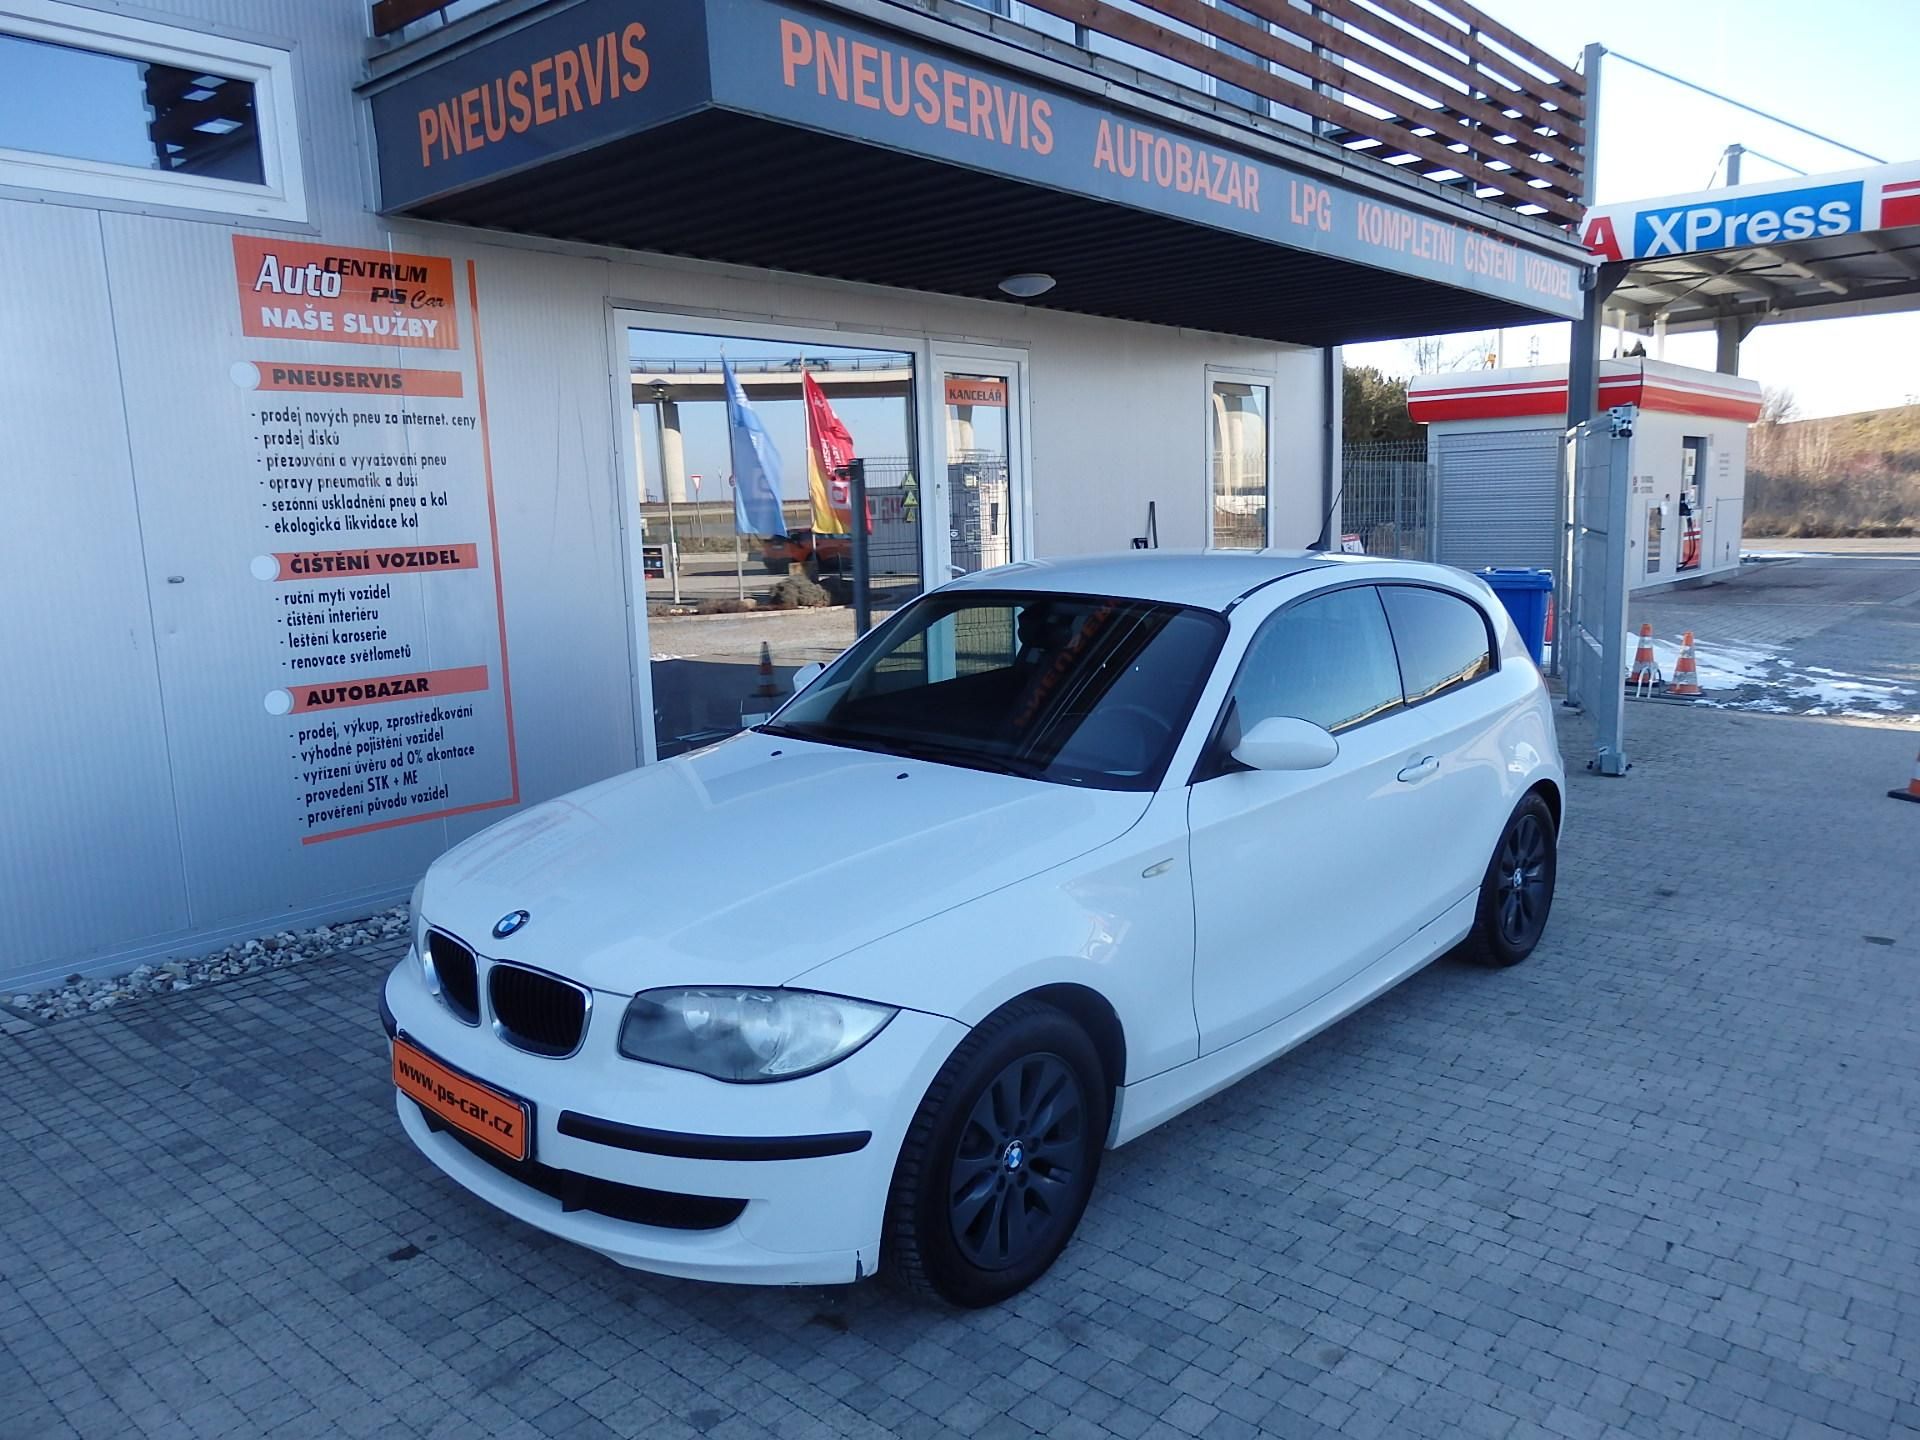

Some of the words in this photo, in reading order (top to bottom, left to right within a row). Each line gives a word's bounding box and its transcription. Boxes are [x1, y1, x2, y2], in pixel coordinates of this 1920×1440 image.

[418, 22, 650, 168] PNEUSERVIS
[780, 18, 1054, 155] PNEUSERVIS
[1093, 118, 1260, 213] AUTOBAZAR
[1291, 180, 1331, 233] LPG
[1358, 201, 1457, 265] KOMPLETNÍ
[1464, 225, 1520, 283] ČIŠTĚNÍ
[1523, 255, 1572, 300] VOZIDEL
[1642, 201, 1851, 258] XPress
[254, 253, 342, 299] Auto
[324, 257, 428, 284] CENTRUM
[370, 286, 408, 305] PS
[411, 290, 446, 309] Car
[261, 303, 335, 332] NAŠE
[343, 310, 438, 339] SLUŽBY
[272, 368, 403, 389] PNEUSERVIS
[949, 387, 1002, 402] KANCELÁŘ
[261, 406, 302, 426] prodej
[306, 408, 348, 427] nových
[353, 413, 380, 428] pneu
[385, 414, 398, 424] za
[402, 409, 448, 425] internet.
[452, 416, 476, 430] ceny
[264, 428, 304, 449] prodej
[308, 429, 340, 445] disků
[267, 452, 335, 471] přezouvání
[340, 456, 346, 466] a
[351, 453, 417, 470] vyvažování
[421, 455, 447, 469] pneu
[269, 478, 313, 493] opravy
[318, 472, 381, 493] pneumatik
[385, 477, 392, 487] a
[397, 471, 418, 487] duší
[272, 496, 318, 511] sezónní
[322, 493, 385, 509] uskladnění
[390, 497, 416, 511] pneu
[420, 497, 427, 506] a
[431, 491, 448, 506] kol
[274, 516, 341, 536] ekologická
[345, 513, 397, 530] likvidace
[401, 512, 419, 528] kol
[290, 551, 370, 573] ČIŠTĚNÍ
[376, 550, 460, 568] VOZIDEL
[284, 589, 314, 605] ruční
[318, 587, 345, 606] mytí
[349, 583, 390, 600] vozidel
[287, 610, 324, 627] čištění
[328, 606, 378, 623] interiéru
[289, 631, 329, 648] leštění
[332, 626, 387, 644] karoserie
[291, 654, 346, 669] renovace
[350, 644, 411, 663] světlometů
[307, 678, 430, 706] AUTOBAZAR
[299, 721, 339, 745] prodej,
[344, 717, 382, 737] výkup,
[386, 704, 473, 731] zprostředkování
[301, 741, 352, 765] výhodné
[357, 733, 402, 757] pojištění
[406, 725, 444, 745] vozidel
[303, 762, 351, 785] vyřízení
[355, 759, 387, 774] úvěru
[390, 751, 403, 768] od
[407, 749, 423, 764] 0%
[427, 746, 475, 761] akontace
[306, 781, 364, 807] provedení
[367, 775, 389, 792] STK
[403, 770, 418, 786] ME
[308, 800, 364, 828] prověření
[368, 792, 407, 816] původu
[411, 783, 449, 804] vozidel
[399, 1059, 514, 1138] www.ps-car.cz
